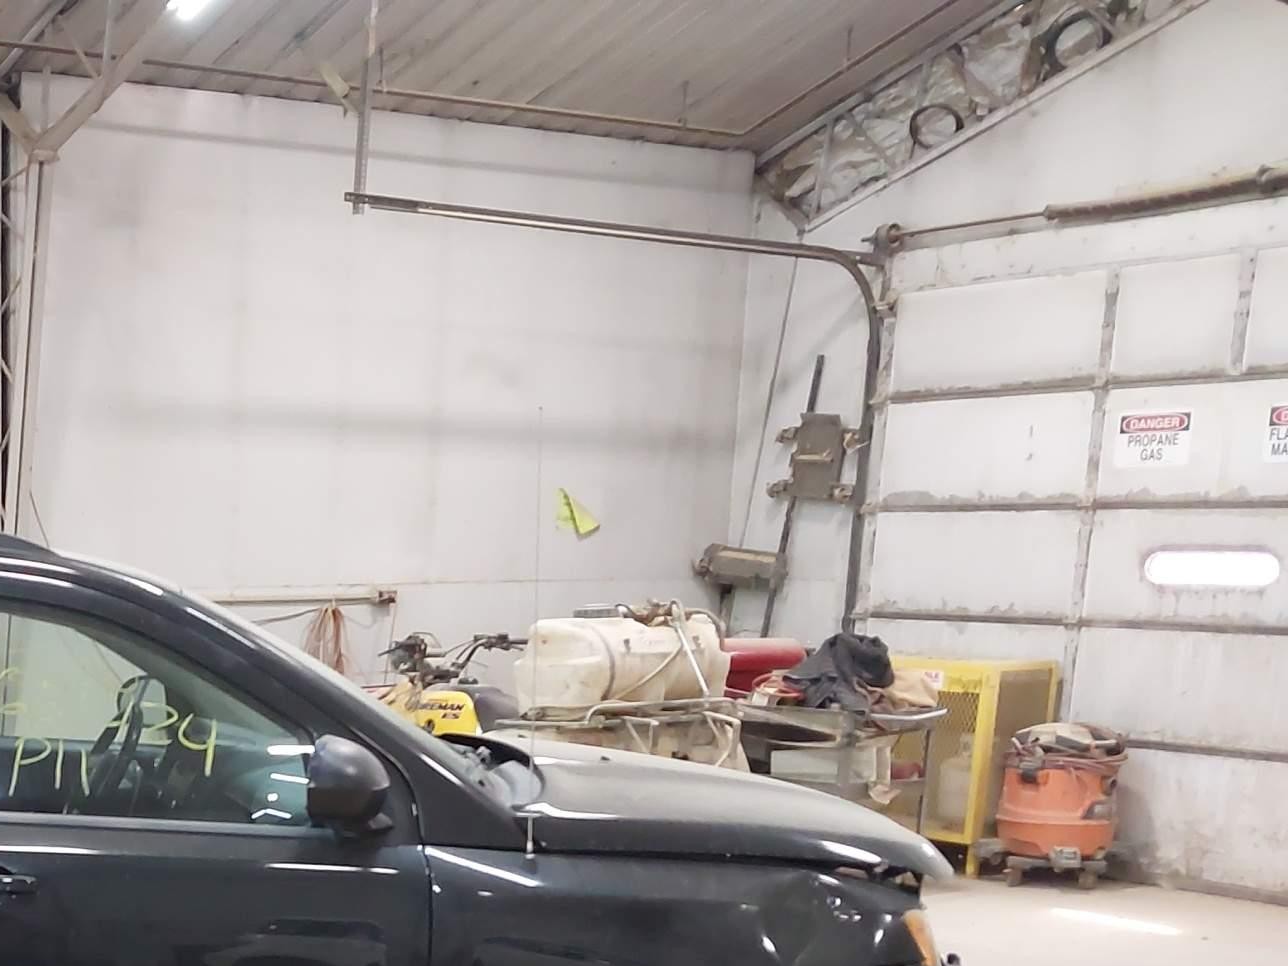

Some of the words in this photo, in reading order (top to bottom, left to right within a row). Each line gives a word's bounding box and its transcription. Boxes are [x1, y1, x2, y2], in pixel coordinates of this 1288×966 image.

[1130, 417, 1181, 429] DANGER
[1127, 433, 1180, 447] PROPANE
[1140, 448, 1163, 461] GAS
